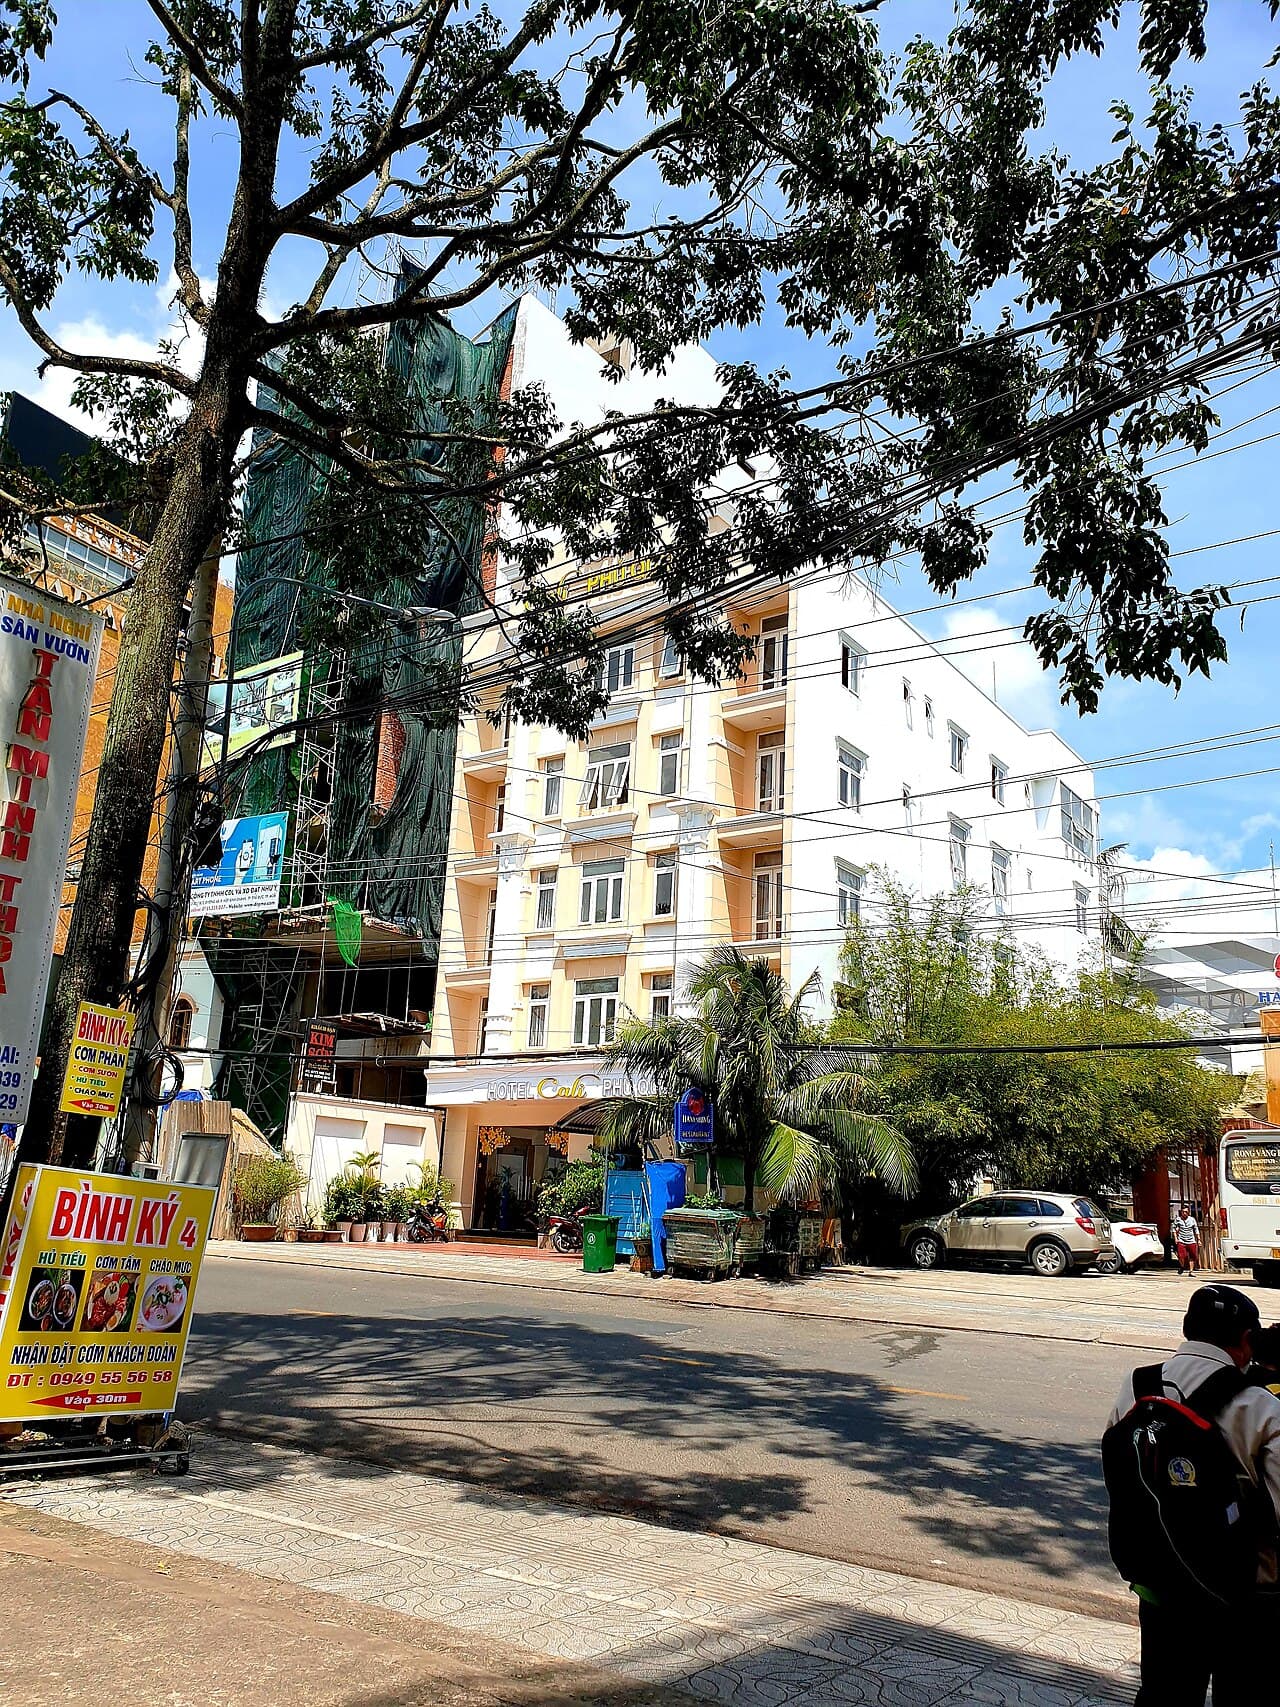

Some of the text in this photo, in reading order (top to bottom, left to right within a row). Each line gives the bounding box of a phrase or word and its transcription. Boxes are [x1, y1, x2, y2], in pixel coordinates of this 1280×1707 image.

[1, 615, 90, 665] SÂN VƯỜN
[1, 743, 50, 863] MINH
[78, 1008, 130, 1047] BÌNH KÝ 4
[309, 1031, 335, 1048] KIM
[487, 1081, 534, 1100] HOTEL
[536, 1073, 600, 1099] Cali
[49, 1181, 198, 1249] BÌNH KÝ 4
[38, 1248, 87, 1267] HỦ TIẾU
[95, 1254, 142, 1271] CƠM TẤM
[11, 1342, 178, 1368] NHẬN ĐẶT CƠM KHÁCH ĐOÀN
[7, 1373, 34, 1388] ĐT
[49, 1371, 96, 1387] 0949
[100, 1371, 123, 1385] 55
[126, 1370, 149, 1385] 56
[152, 1370, 174, 1384] 58
[64, 1394, 127, 1405] Vào 30m
